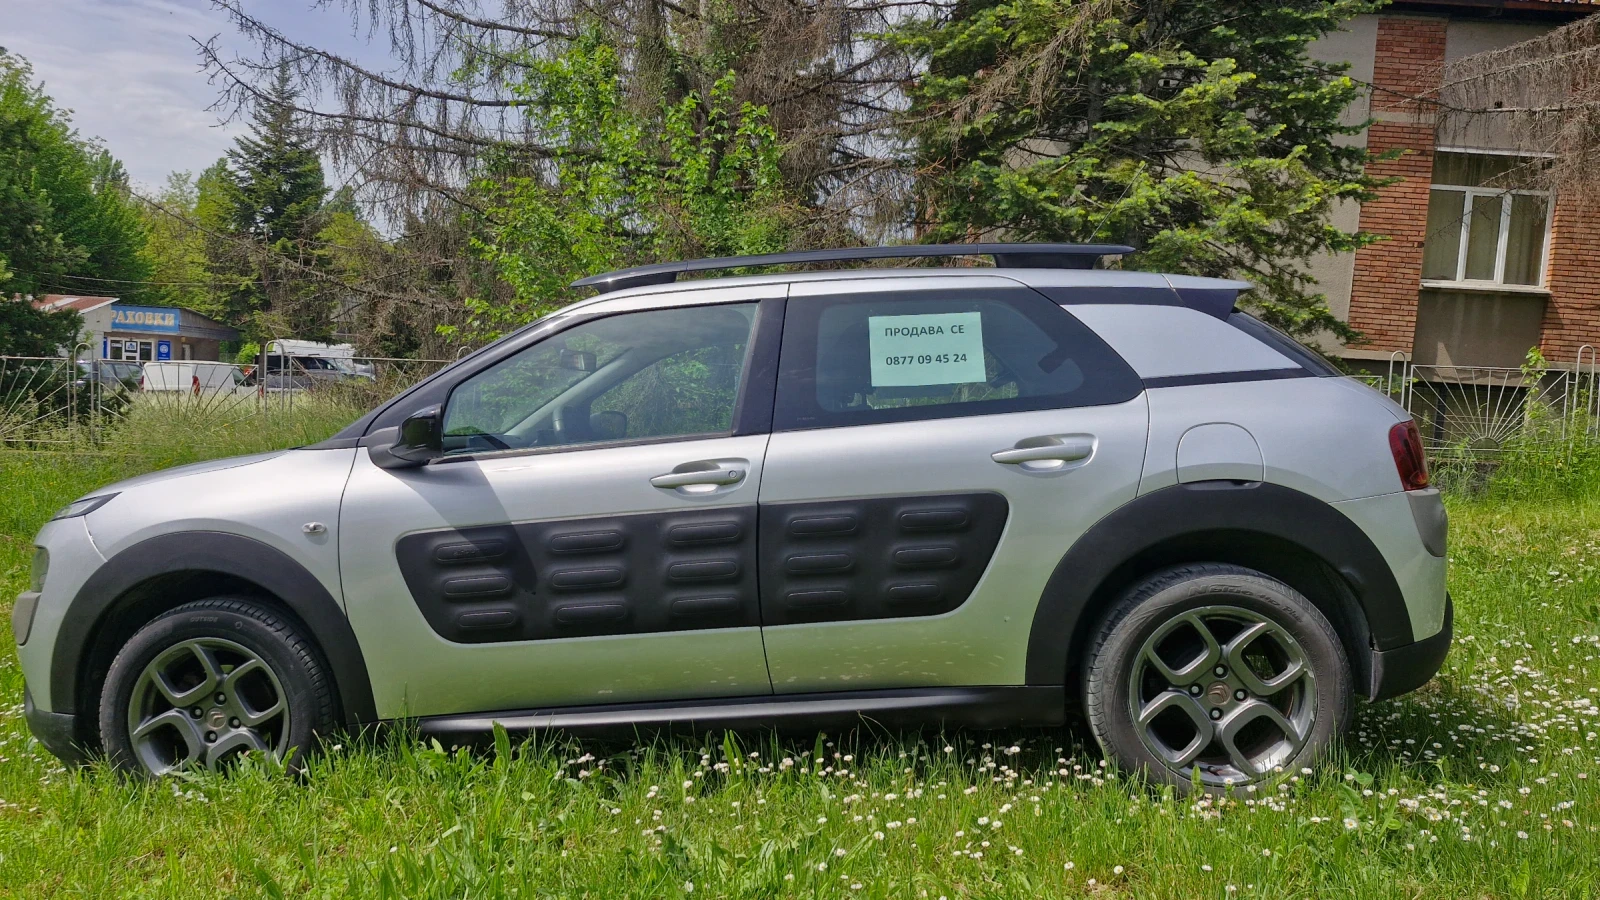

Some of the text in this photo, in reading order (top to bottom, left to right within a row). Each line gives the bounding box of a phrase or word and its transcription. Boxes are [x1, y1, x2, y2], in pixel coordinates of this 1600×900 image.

[885, 325, 964, 337] ПРОДАВА СЕ
[886, 353, 967, 365] 0877 09 45 24
